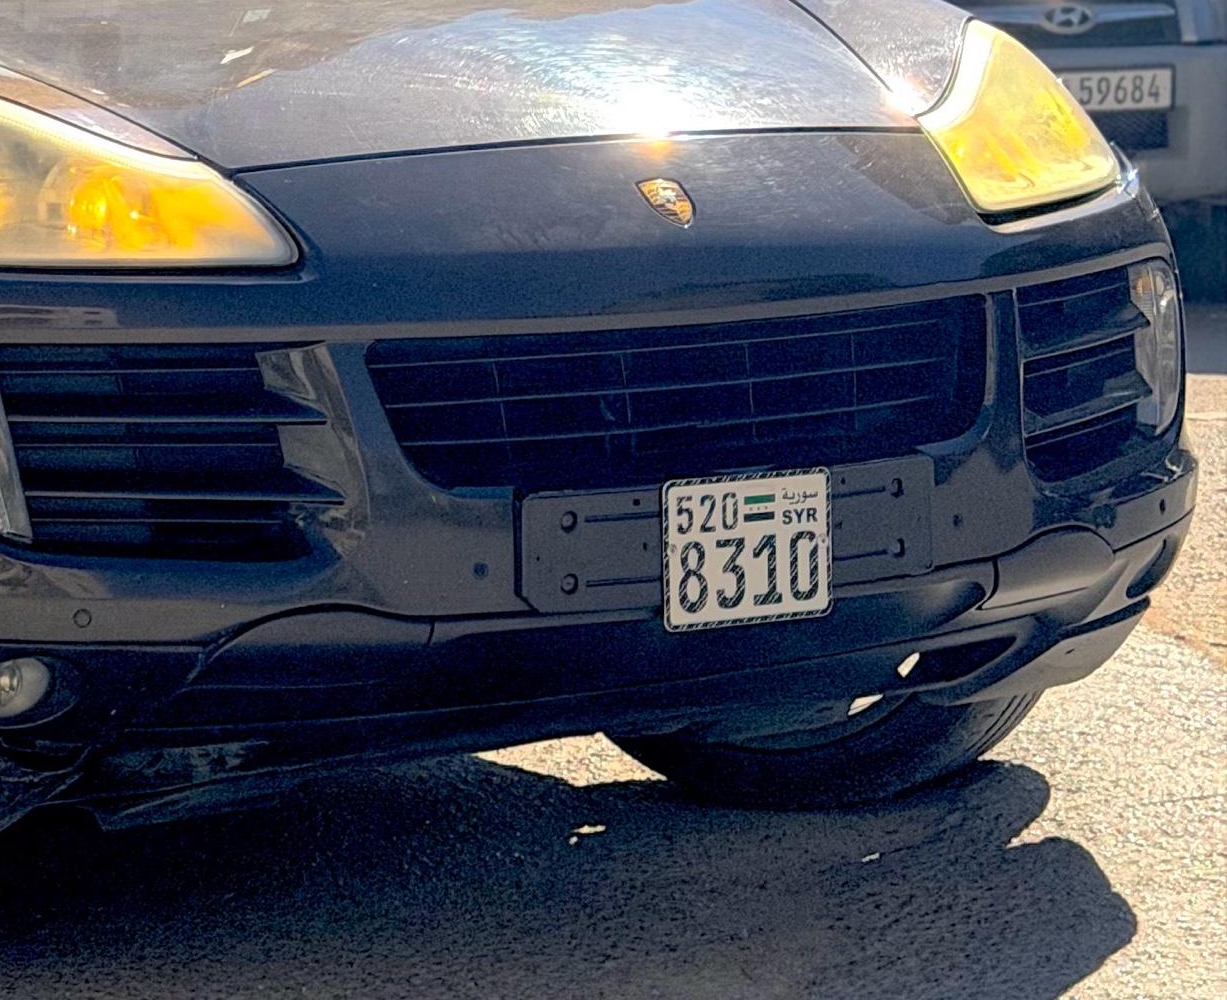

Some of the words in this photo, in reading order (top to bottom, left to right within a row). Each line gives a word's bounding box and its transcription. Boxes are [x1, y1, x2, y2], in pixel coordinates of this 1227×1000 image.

[1079, 74, 1160, 105] 59684
[781, 488, 819, 506] سورية
[675, 491, 739, 535] 520
[781, 507, 819, 525] SYR
[678, 530, 820, 614] 8310
